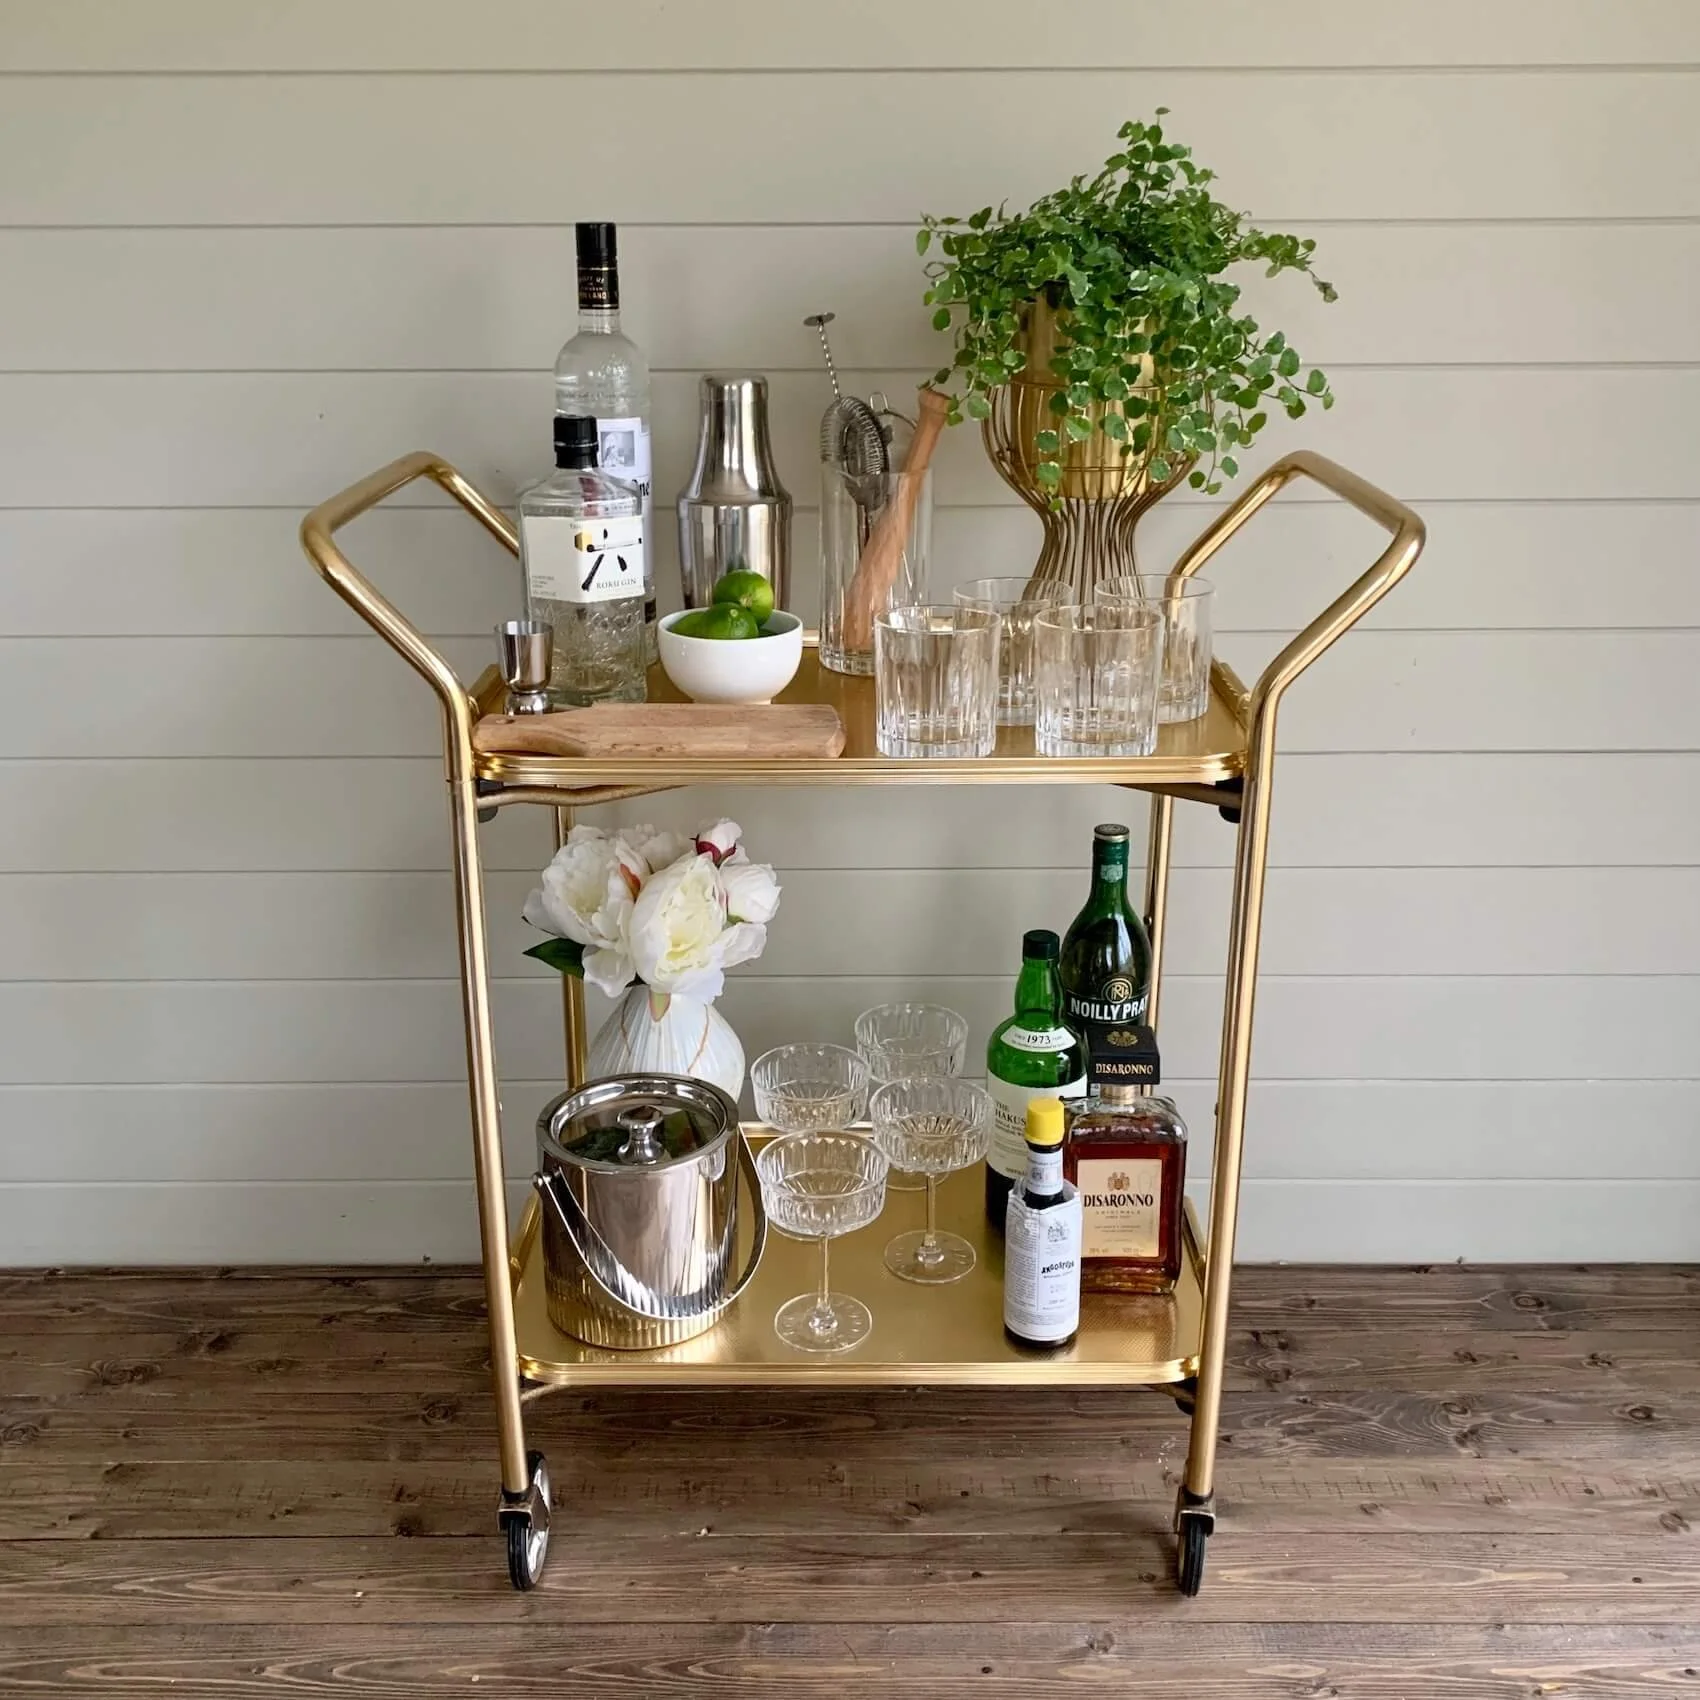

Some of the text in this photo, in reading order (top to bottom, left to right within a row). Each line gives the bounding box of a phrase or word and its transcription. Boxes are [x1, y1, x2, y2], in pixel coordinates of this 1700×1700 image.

[596, 578, 637, 589] ROKU GIN
[1071, 997, 1120, 1020] NOILLY
[1027, 1034, 1051, 1045] 1973
[1096, 1063, 1153, 1075] DISARONNO
[1083, 1193, 1154, 1208] DISARONNO
